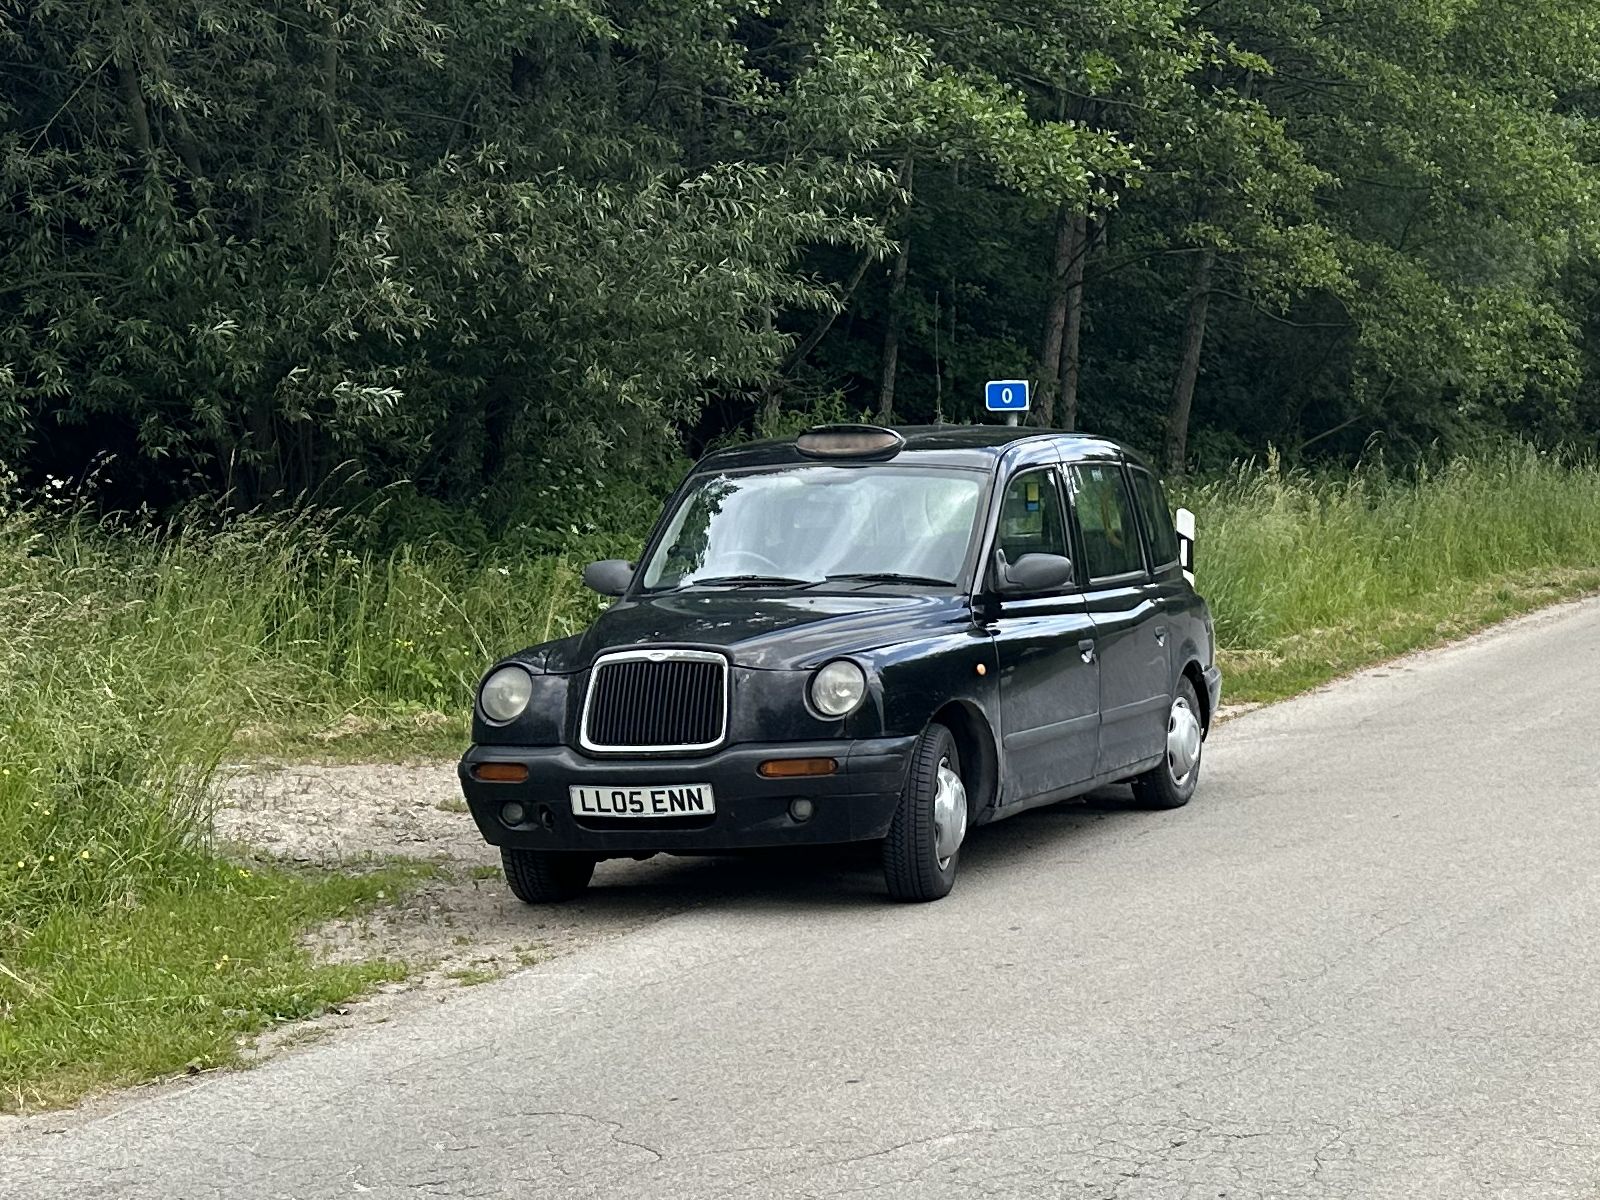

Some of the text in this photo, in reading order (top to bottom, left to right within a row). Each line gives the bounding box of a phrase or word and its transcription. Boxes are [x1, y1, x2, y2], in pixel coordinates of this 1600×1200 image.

[1002, 388, 1012, 404] 0
[579, 787, 705, 813] LL05 ENN
